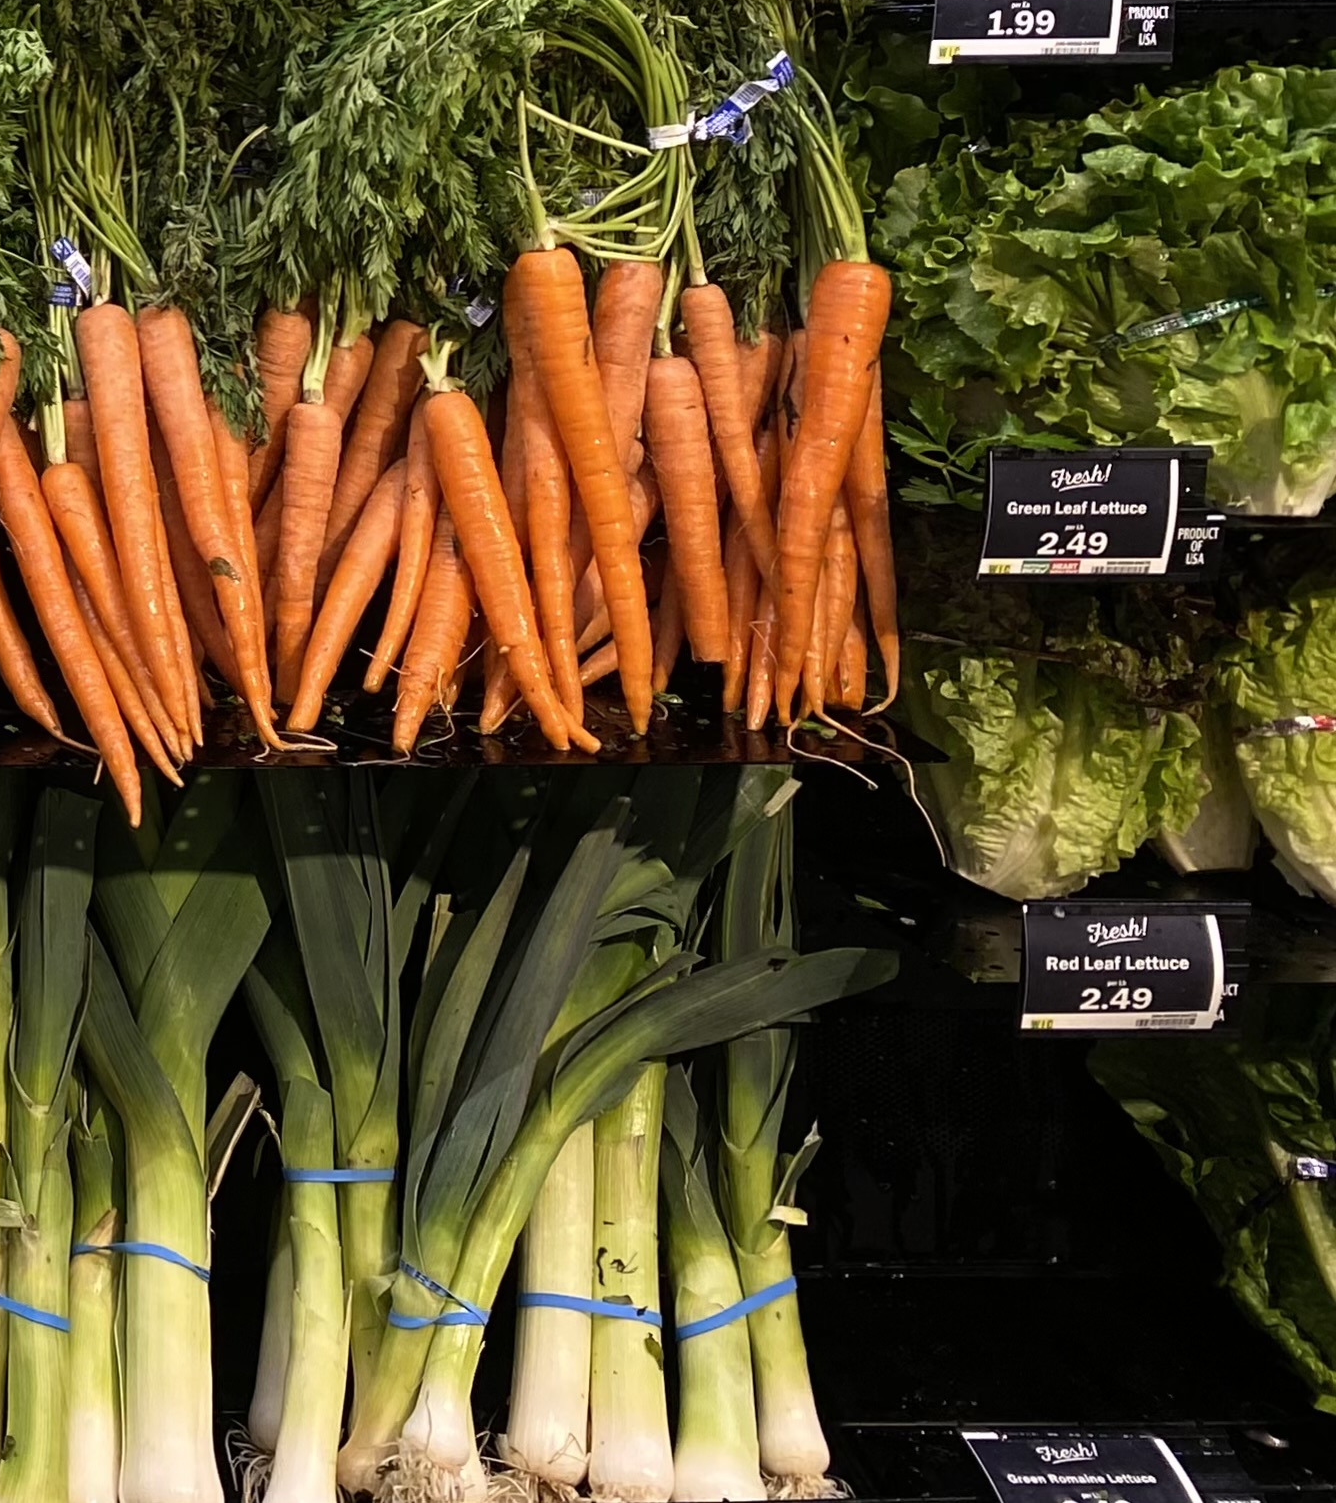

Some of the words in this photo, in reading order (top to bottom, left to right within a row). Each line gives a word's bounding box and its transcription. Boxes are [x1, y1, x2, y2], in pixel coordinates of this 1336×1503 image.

[1128, 5, 1170, 20] PRODUCT
[986, 9, 1056, 36] 1.99
[1142, 20, 1156, 33] OF
[1138, 33, 1157, 46] USA
[1051, 463, 1112, 489] Fresh!
[1007, 501, 1051, 515] Green
[1055, 501, 1086, 515] Leaf
[1091, 501, 1147, 515] Lettuce
[1177, 527, 1220, 541] PRODUCT
[1036, 531, 1108, 555] 2.49
[1190, 540, 1203, 552] OF
[1185, 552, 1205, 565] USA
[1051, 562, 1078, 570] HEART
[1086, 916, 1148, 943] Fresh!
[1046, 956, 1079, 971] Red
[1084, 956, 1121, 971] Leaf
[1125, 956, 1190, 971] Lettuce
[1079, 987, 1153, 1011] 2.49
[1036, 1442, 1099, 1462] Fresh!
[1007, 1474, 1047, 1485] Green
[1047, 1474, 1106, 1485] Romaine
[1107, 1474, 1157, 1485] Lettuce
